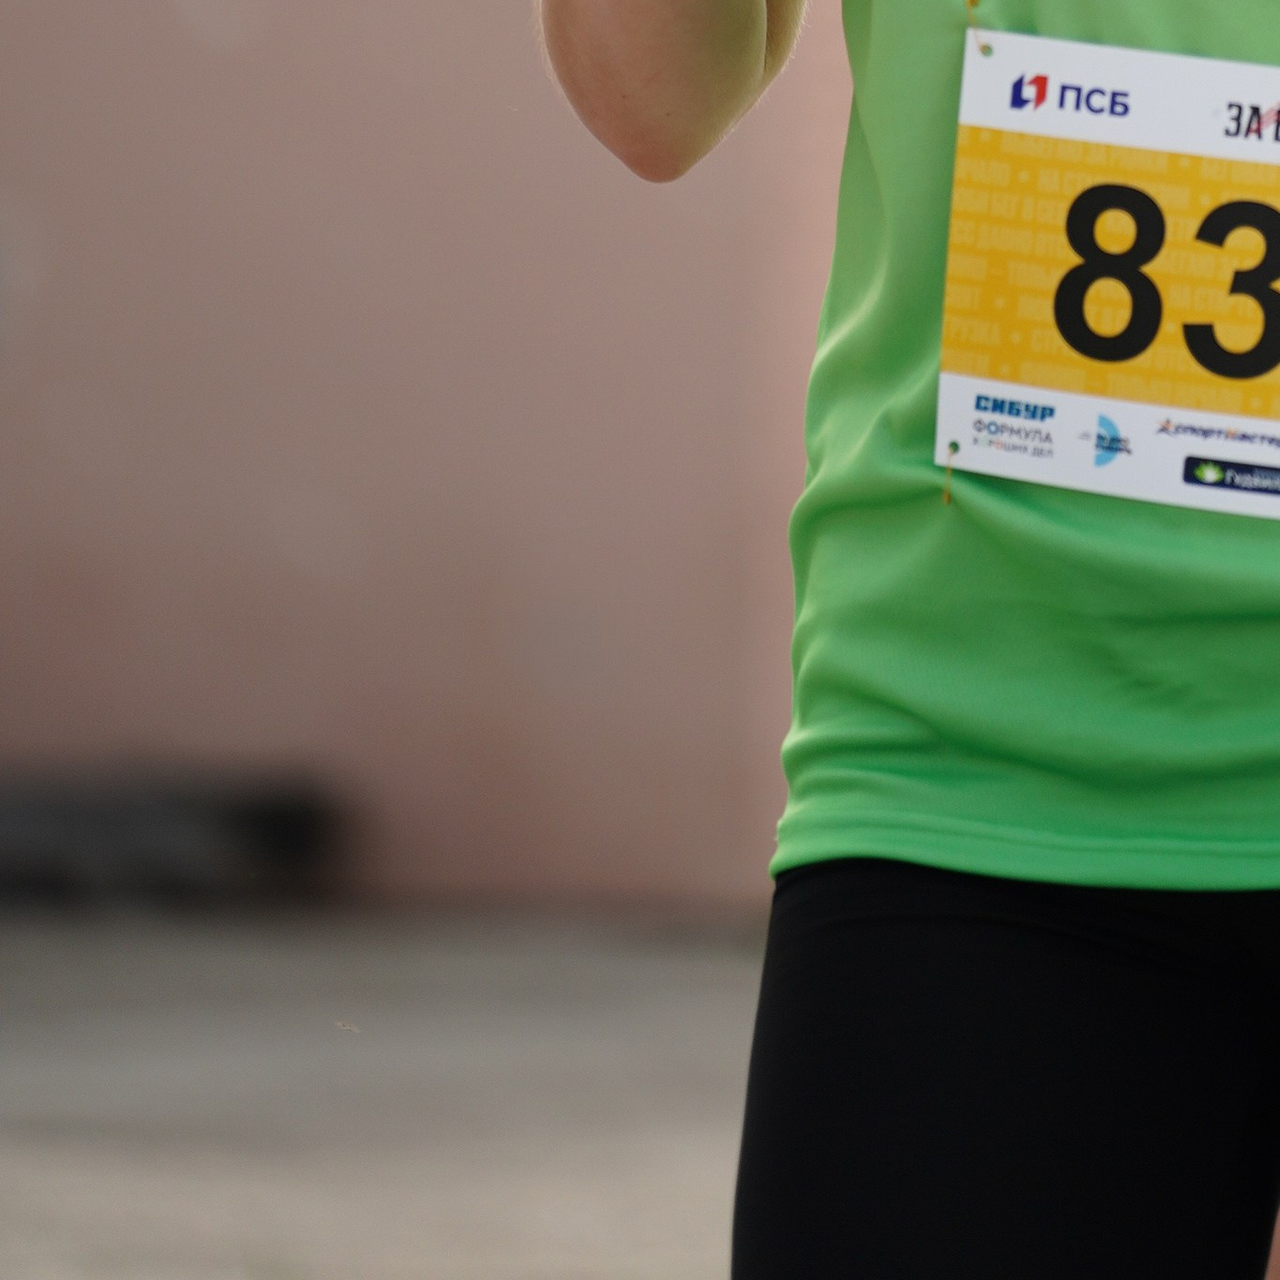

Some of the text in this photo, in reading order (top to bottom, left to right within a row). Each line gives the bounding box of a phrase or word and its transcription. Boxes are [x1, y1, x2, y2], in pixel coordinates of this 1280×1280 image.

[1058, 84, 1130, 118] ПСБ
[975, 394, 1056, 422] СИБУР
[973, 418, 1053, 444] ФОРМУЛА
